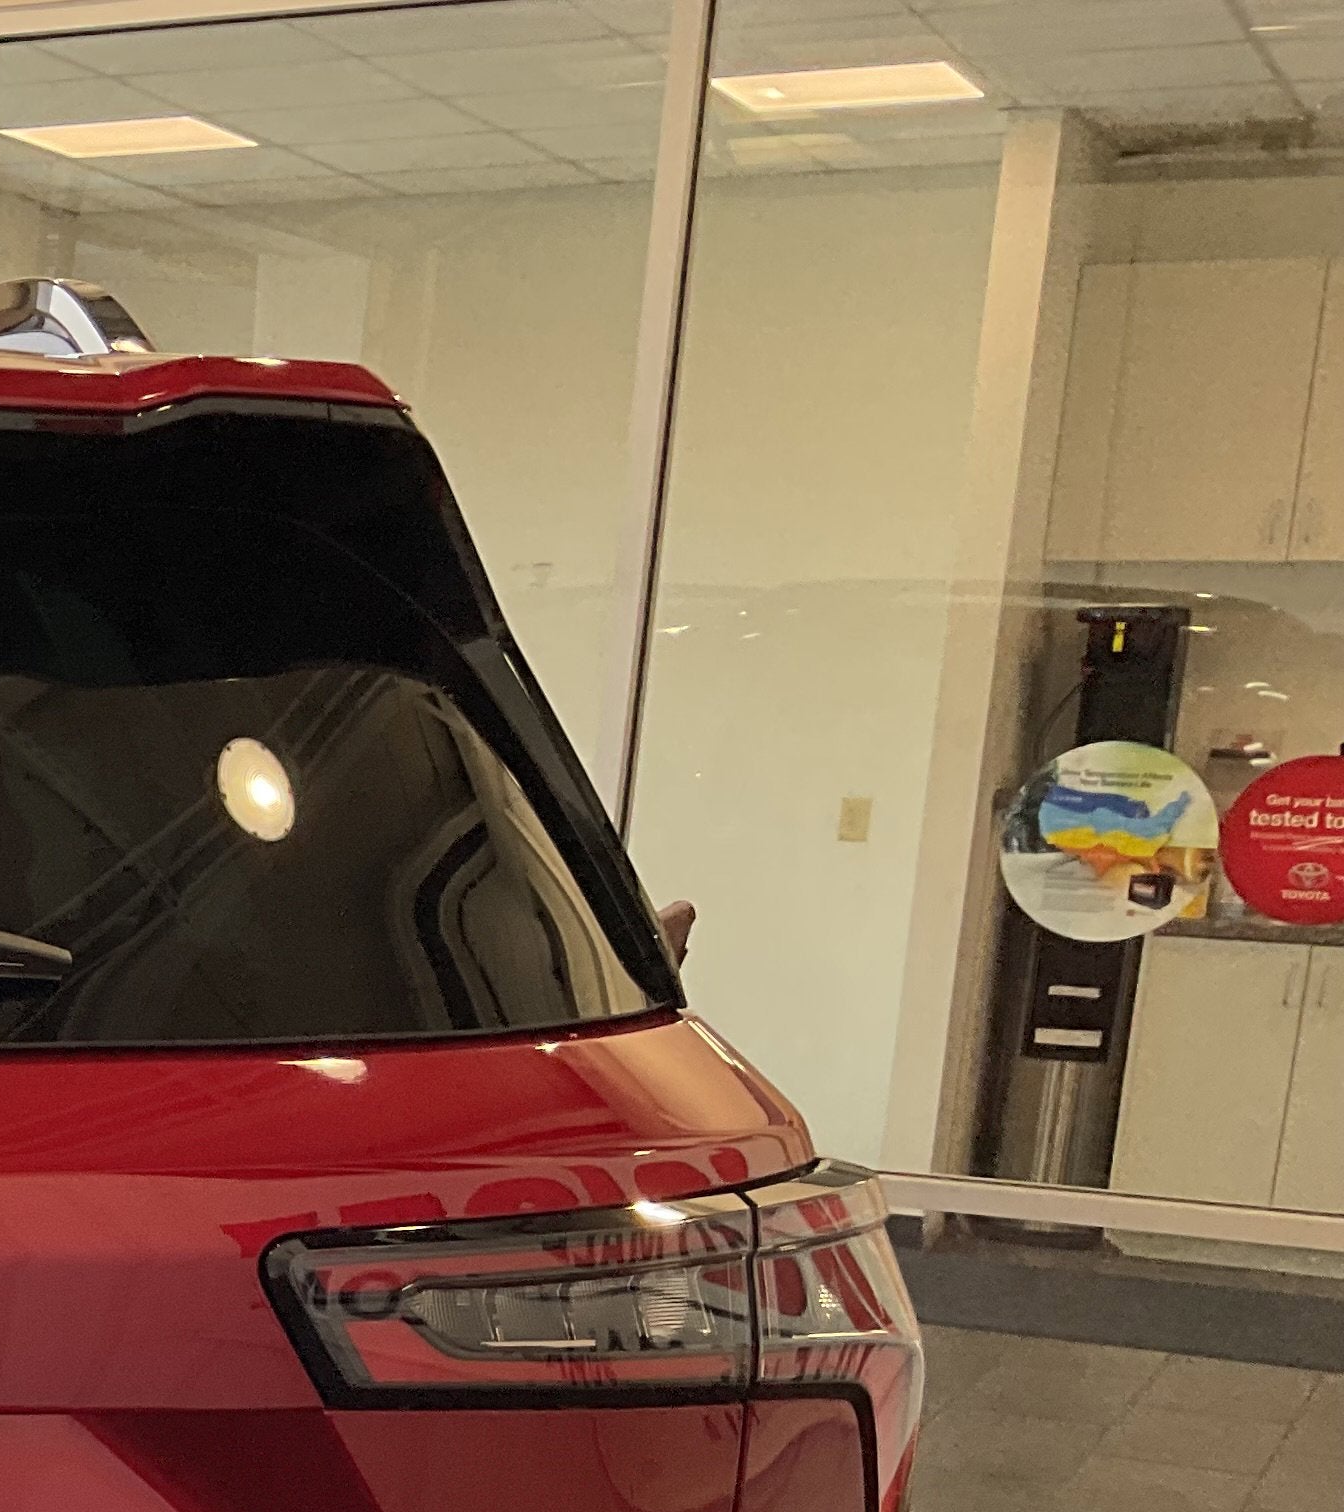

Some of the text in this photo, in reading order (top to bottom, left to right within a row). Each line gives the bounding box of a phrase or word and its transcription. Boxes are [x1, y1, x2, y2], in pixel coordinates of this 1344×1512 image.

[1265, 794, 1291, 806] Get
[1249, 809, 1319, 829] tested
[1280, 889, 1331, 901] TOYOTA
